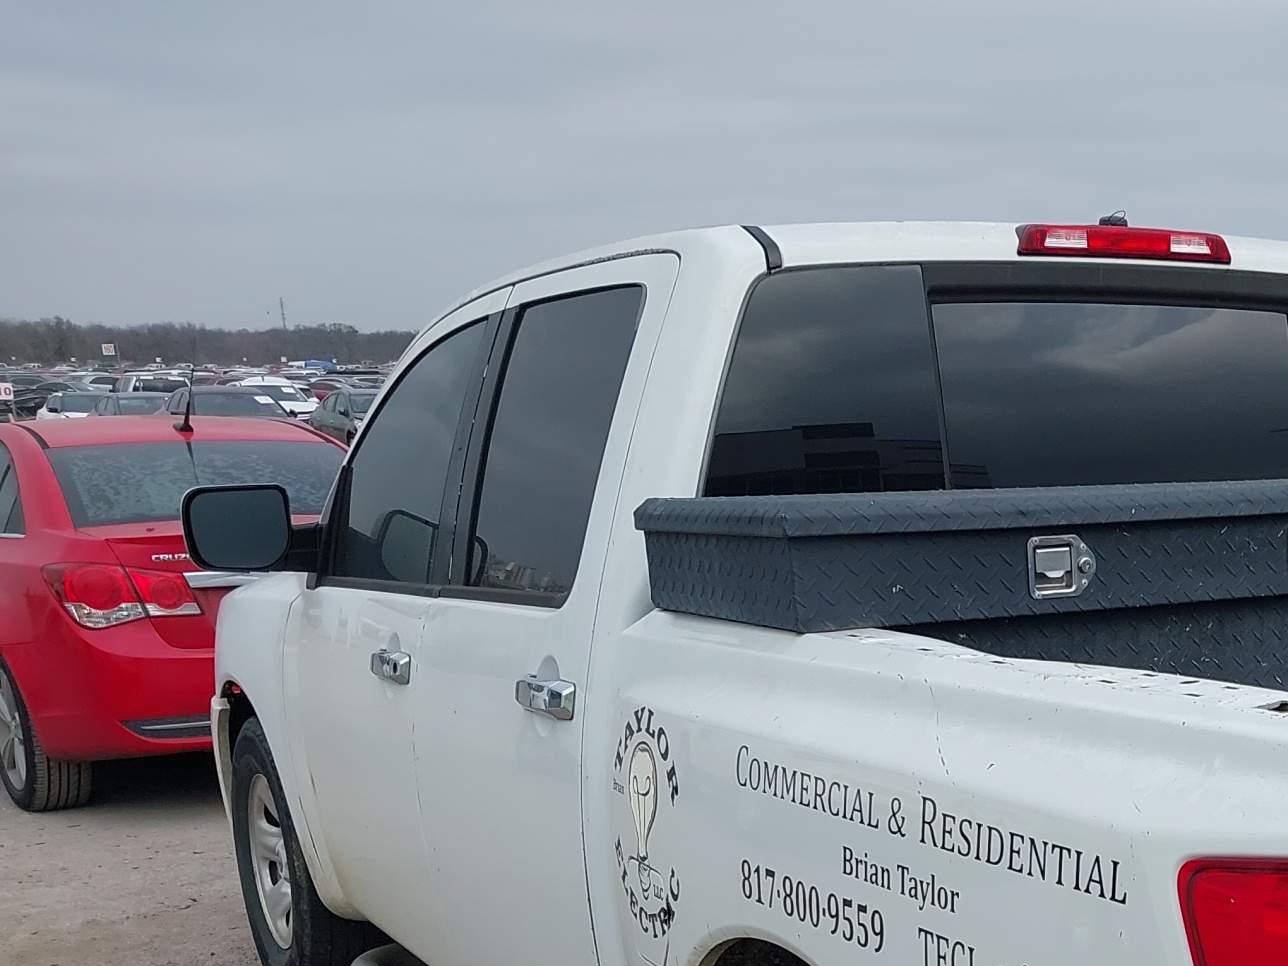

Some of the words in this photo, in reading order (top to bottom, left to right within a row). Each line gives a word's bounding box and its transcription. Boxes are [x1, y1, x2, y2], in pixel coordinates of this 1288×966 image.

[614, 706, 679, 807] TAYLOR
[887, 797, 907, 838] &
[841, 846, 891, 890] Brian
[896, 864, 960, 914] Taylor
